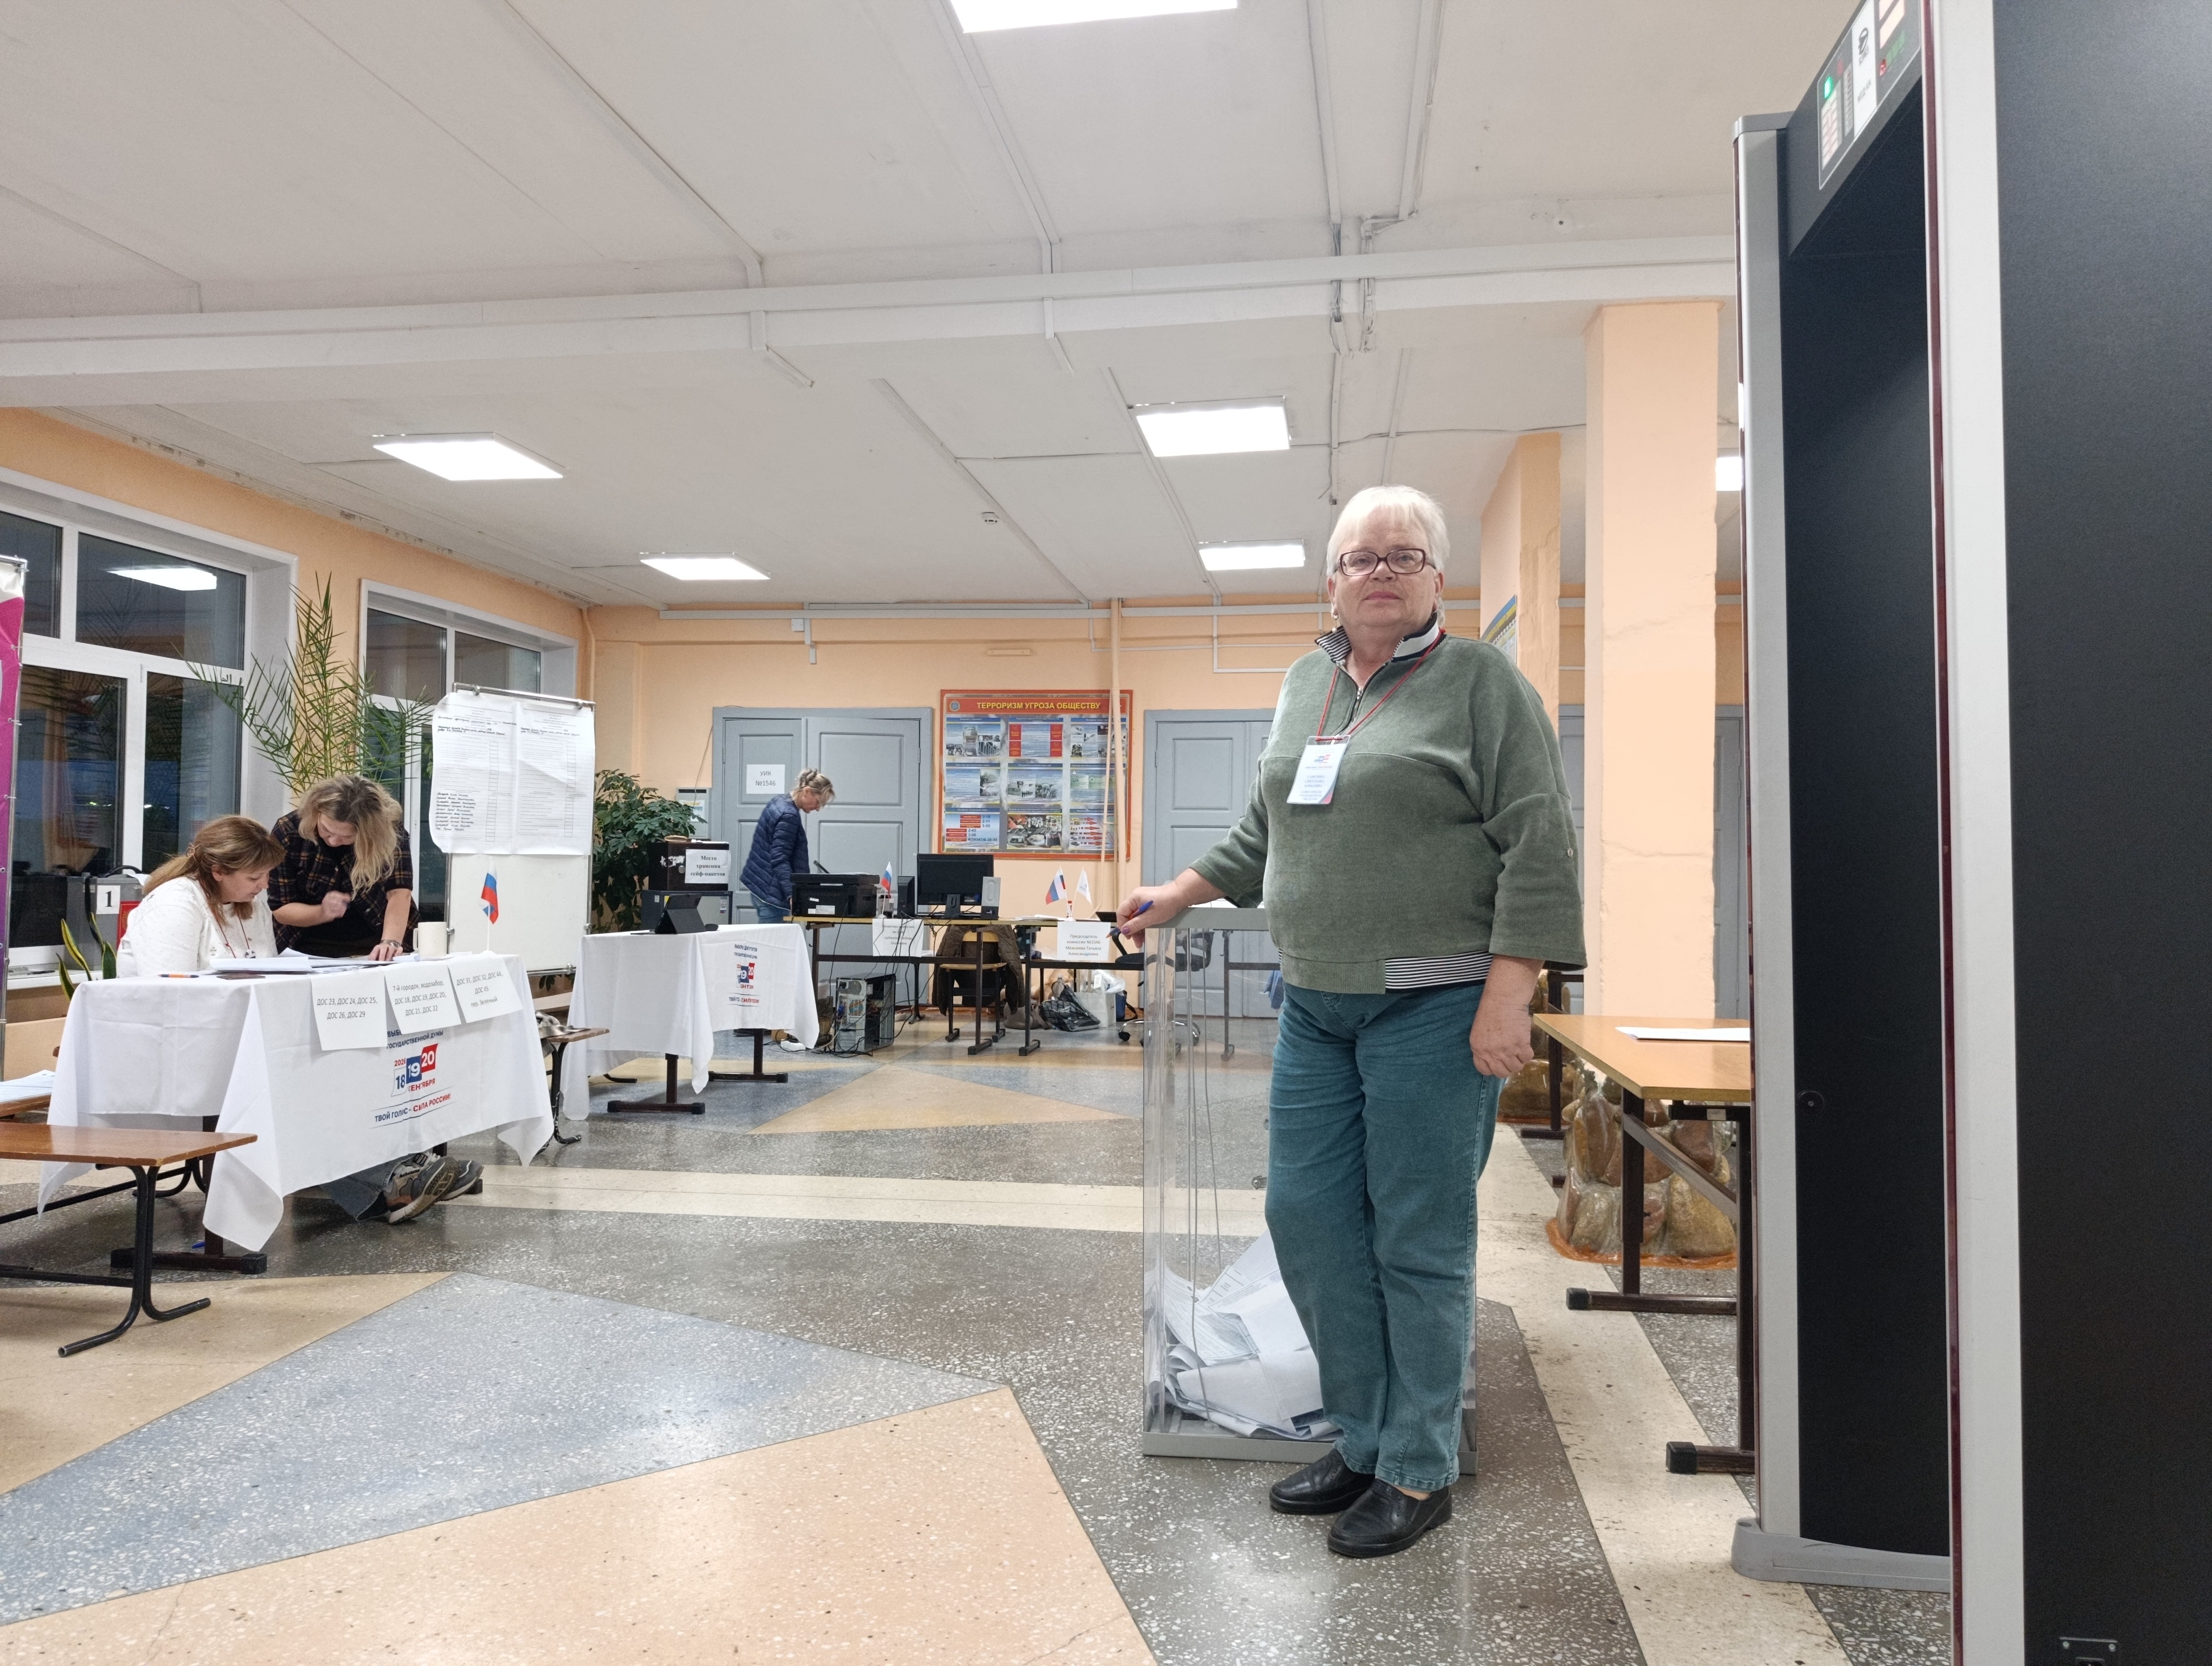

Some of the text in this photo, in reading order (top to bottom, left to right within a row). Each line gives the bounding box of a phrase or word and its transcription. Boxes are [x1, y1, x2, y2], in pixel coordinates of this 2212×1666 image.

[105, 890, 112, 907] 1
[748, 966, 754, 976] 20
[456, 978, 465, 986] ДОС
[475, 986, 484, 995] ДОС
[317, 998, 327, 1007] ДОС
[337, 998, 349, 1006] ДОС
[395, 997, 404, 1006] ДОС
[412, 995, 421, 1003] ДОС
[429, 992, 439, 1001] ДОС
[327, 1012, 338, 1020] ДОС
[406, 1009, 415, 1017] ДОС
[422, 1006, 432, 1014] ДОС
[430, 1030, 443, 1039] ДУМЫ
[421, 1050, 435, 1067] 20
[408, 1062, 421, 1078] 19
[396, 1074, 406, 1090] 18
[408, 1078, 435, 1092] СЕНТЯБРЯ
[375, 1111, 390, 1122] ТВОЙ
[391, 1107, 408, 1119] ГОЛОС
[413, 1101, 428, 1112] СИЛА
[429, 1093, 451, 1107] РОССИИ!
